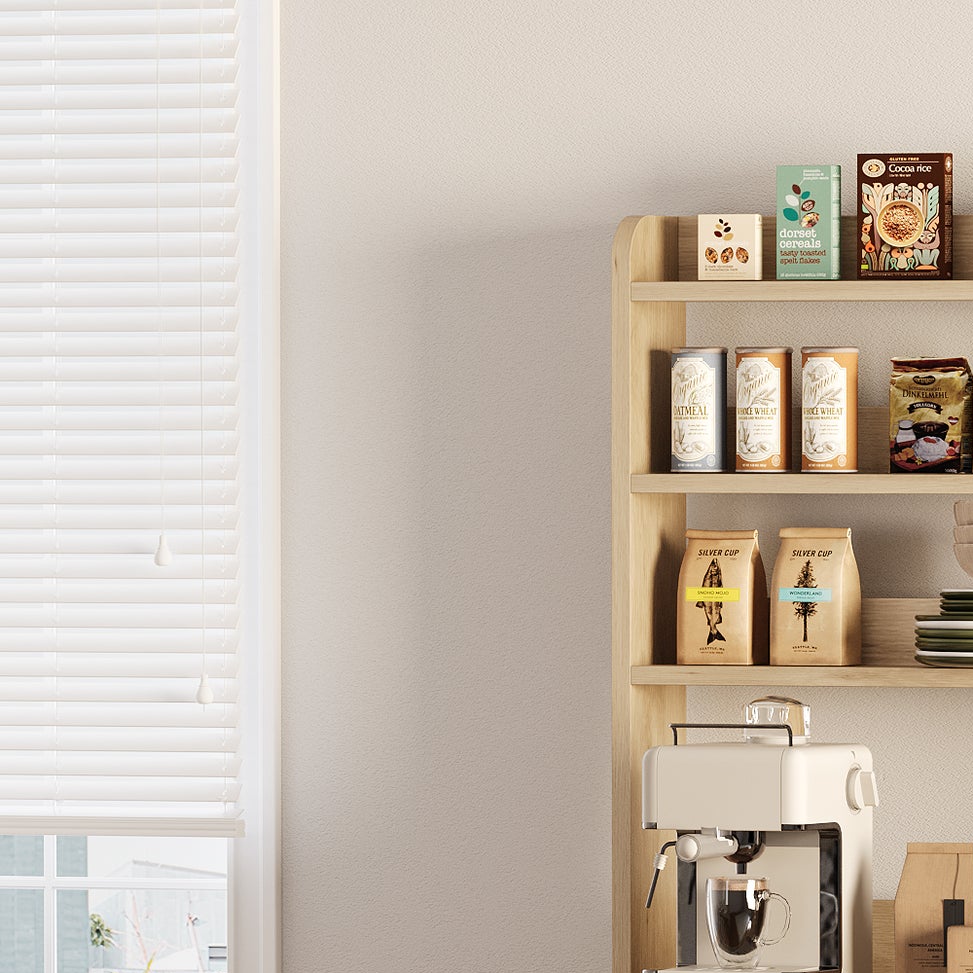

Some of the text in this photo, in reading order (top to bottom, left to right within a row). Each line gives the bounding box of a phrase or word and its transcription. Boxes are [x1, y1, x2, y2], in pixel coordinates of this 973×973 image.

[888, 164, 932, 173] Cocoa rice
[779, 228, 817, 238] dorset
[779, 238, 821, 249] cereals
[698, 549, 740, 557] SILVER CUP
[792, 549, 817, 557] SILVER
